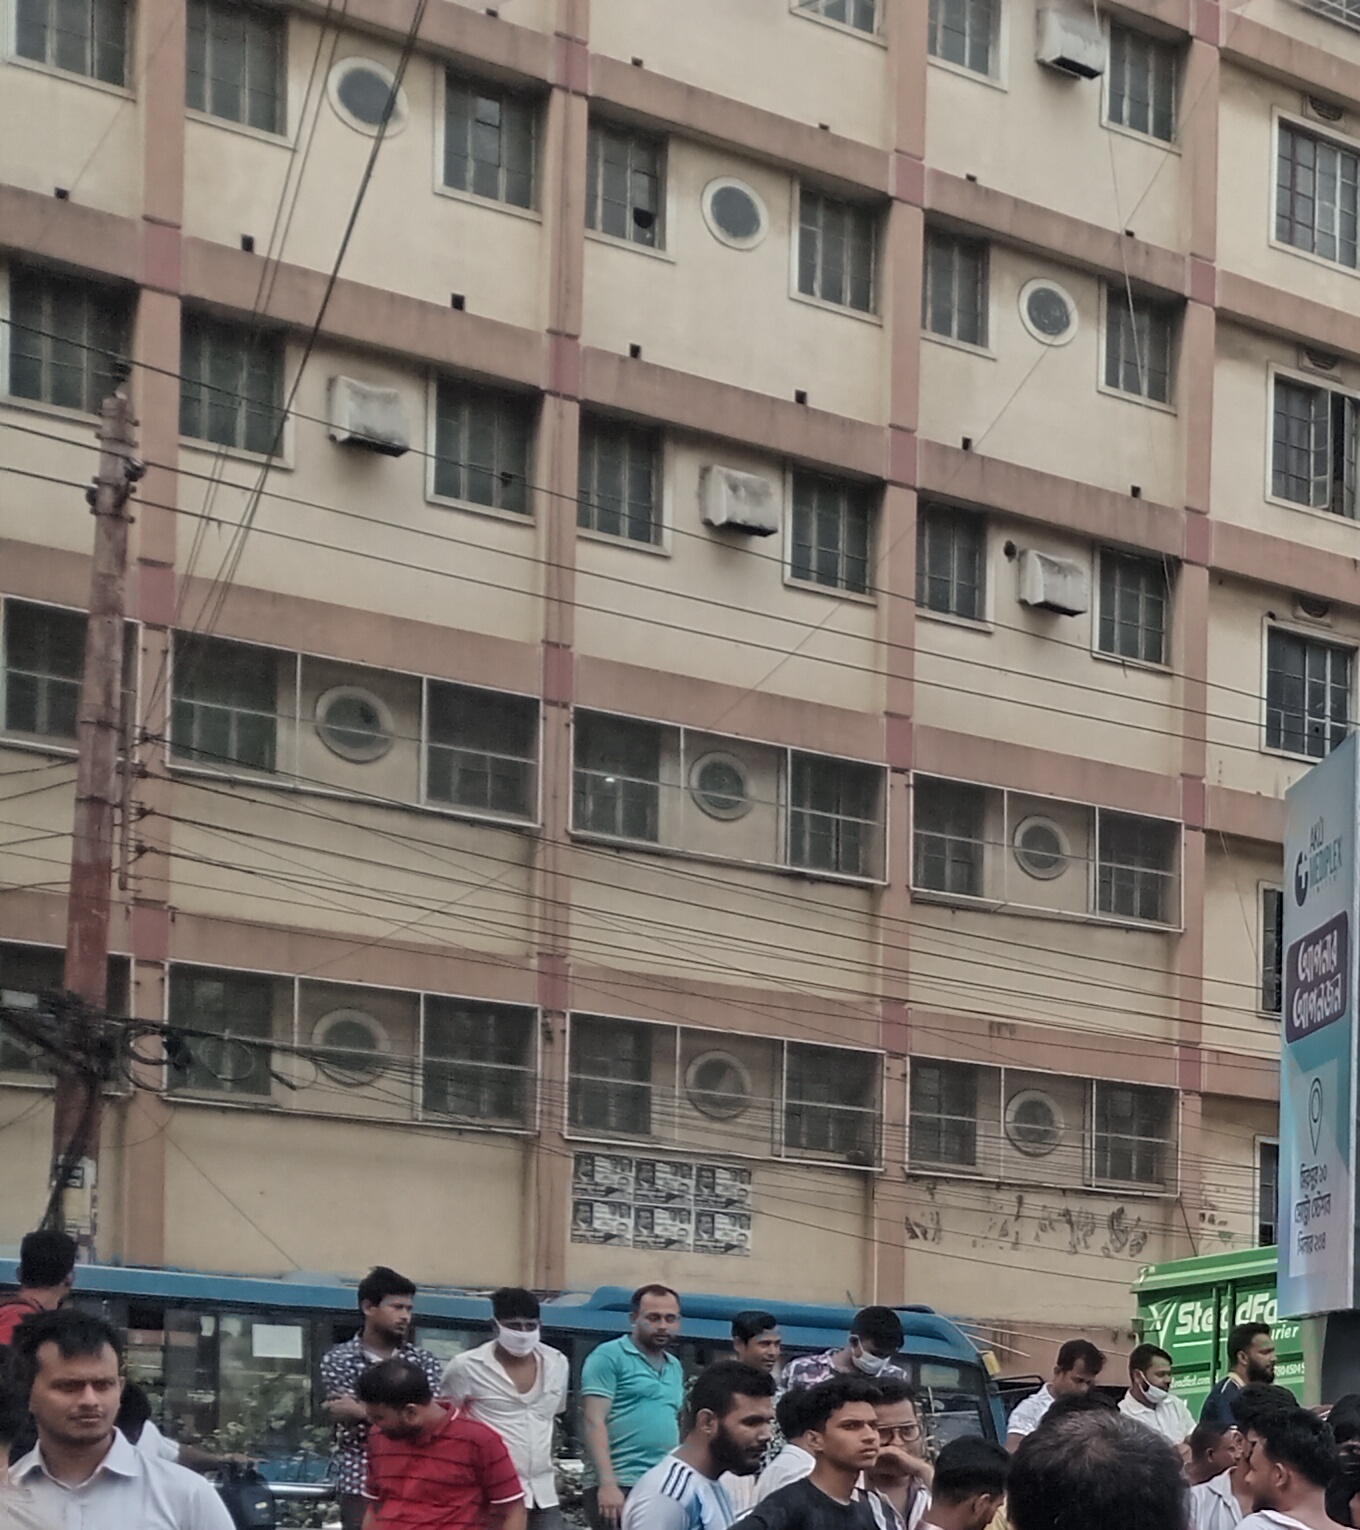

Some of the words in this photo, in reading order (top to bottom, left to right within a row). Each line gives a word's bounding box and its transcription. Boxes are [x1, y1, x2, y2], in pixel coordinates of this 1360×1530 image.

[1298, 929, 1338, 982] আপনার
[1292, 973, 1342, 1029] আপনজন
[1300, 1162, 1319, 1191] মিরপুর
[1174, 1293, 1279, 1336] SteadFa
